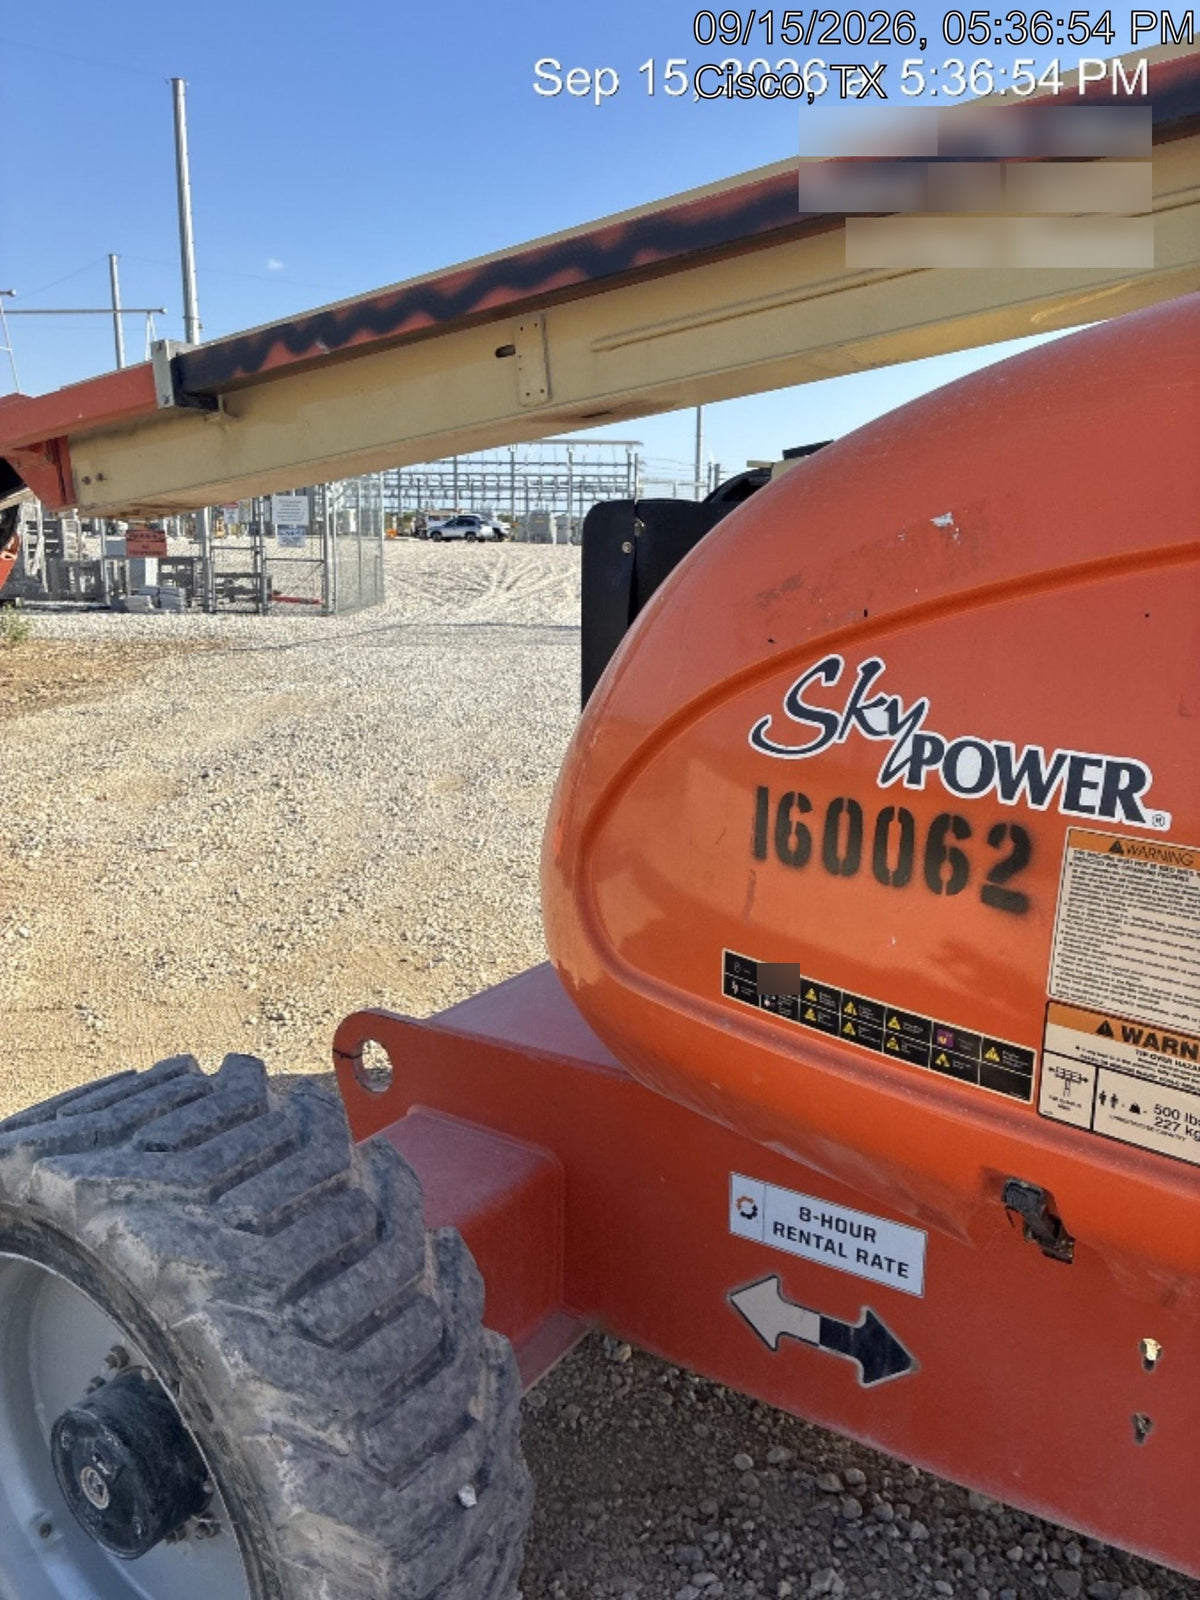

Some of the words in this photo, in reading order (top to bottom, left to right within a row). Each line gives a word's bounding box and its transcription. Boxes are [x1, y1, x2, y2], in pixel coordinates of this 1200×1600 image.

[752, 784, 1033, 916] 160062
[1126, 842, 1195, 868] WARNING
[1154, 1103, 1180, 1121] 500
[1154, 1116, 1181, 1132] 227
[772, 1220, 848, 1259] RENTAL
[855, 1247, 910, 1280] RATE
